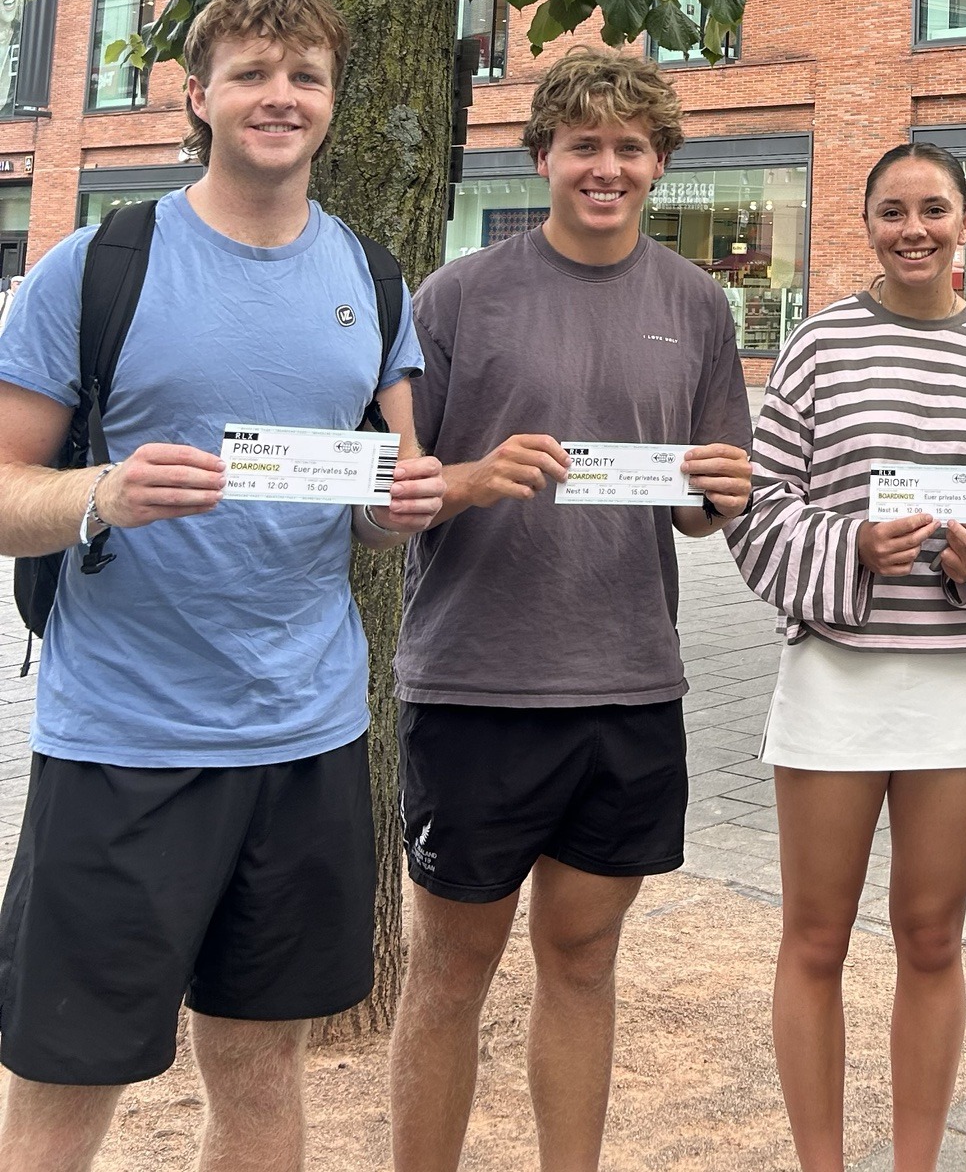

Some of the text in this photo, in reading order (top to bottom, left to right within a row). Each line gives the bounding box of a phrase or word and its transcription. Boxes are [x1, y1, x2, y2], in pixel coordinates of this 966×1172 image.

[233, 443, 290, 456] PRIORITY
[571, 458, 615, 467] PRIORITY
[312, 466, 343, 475] privates
[344, 466, 358, 476] Spa
[661, 475, 673, 483] Spa
[878, 479, 920, 488] PRIORITY
[938, 494, 961, 502] privates
